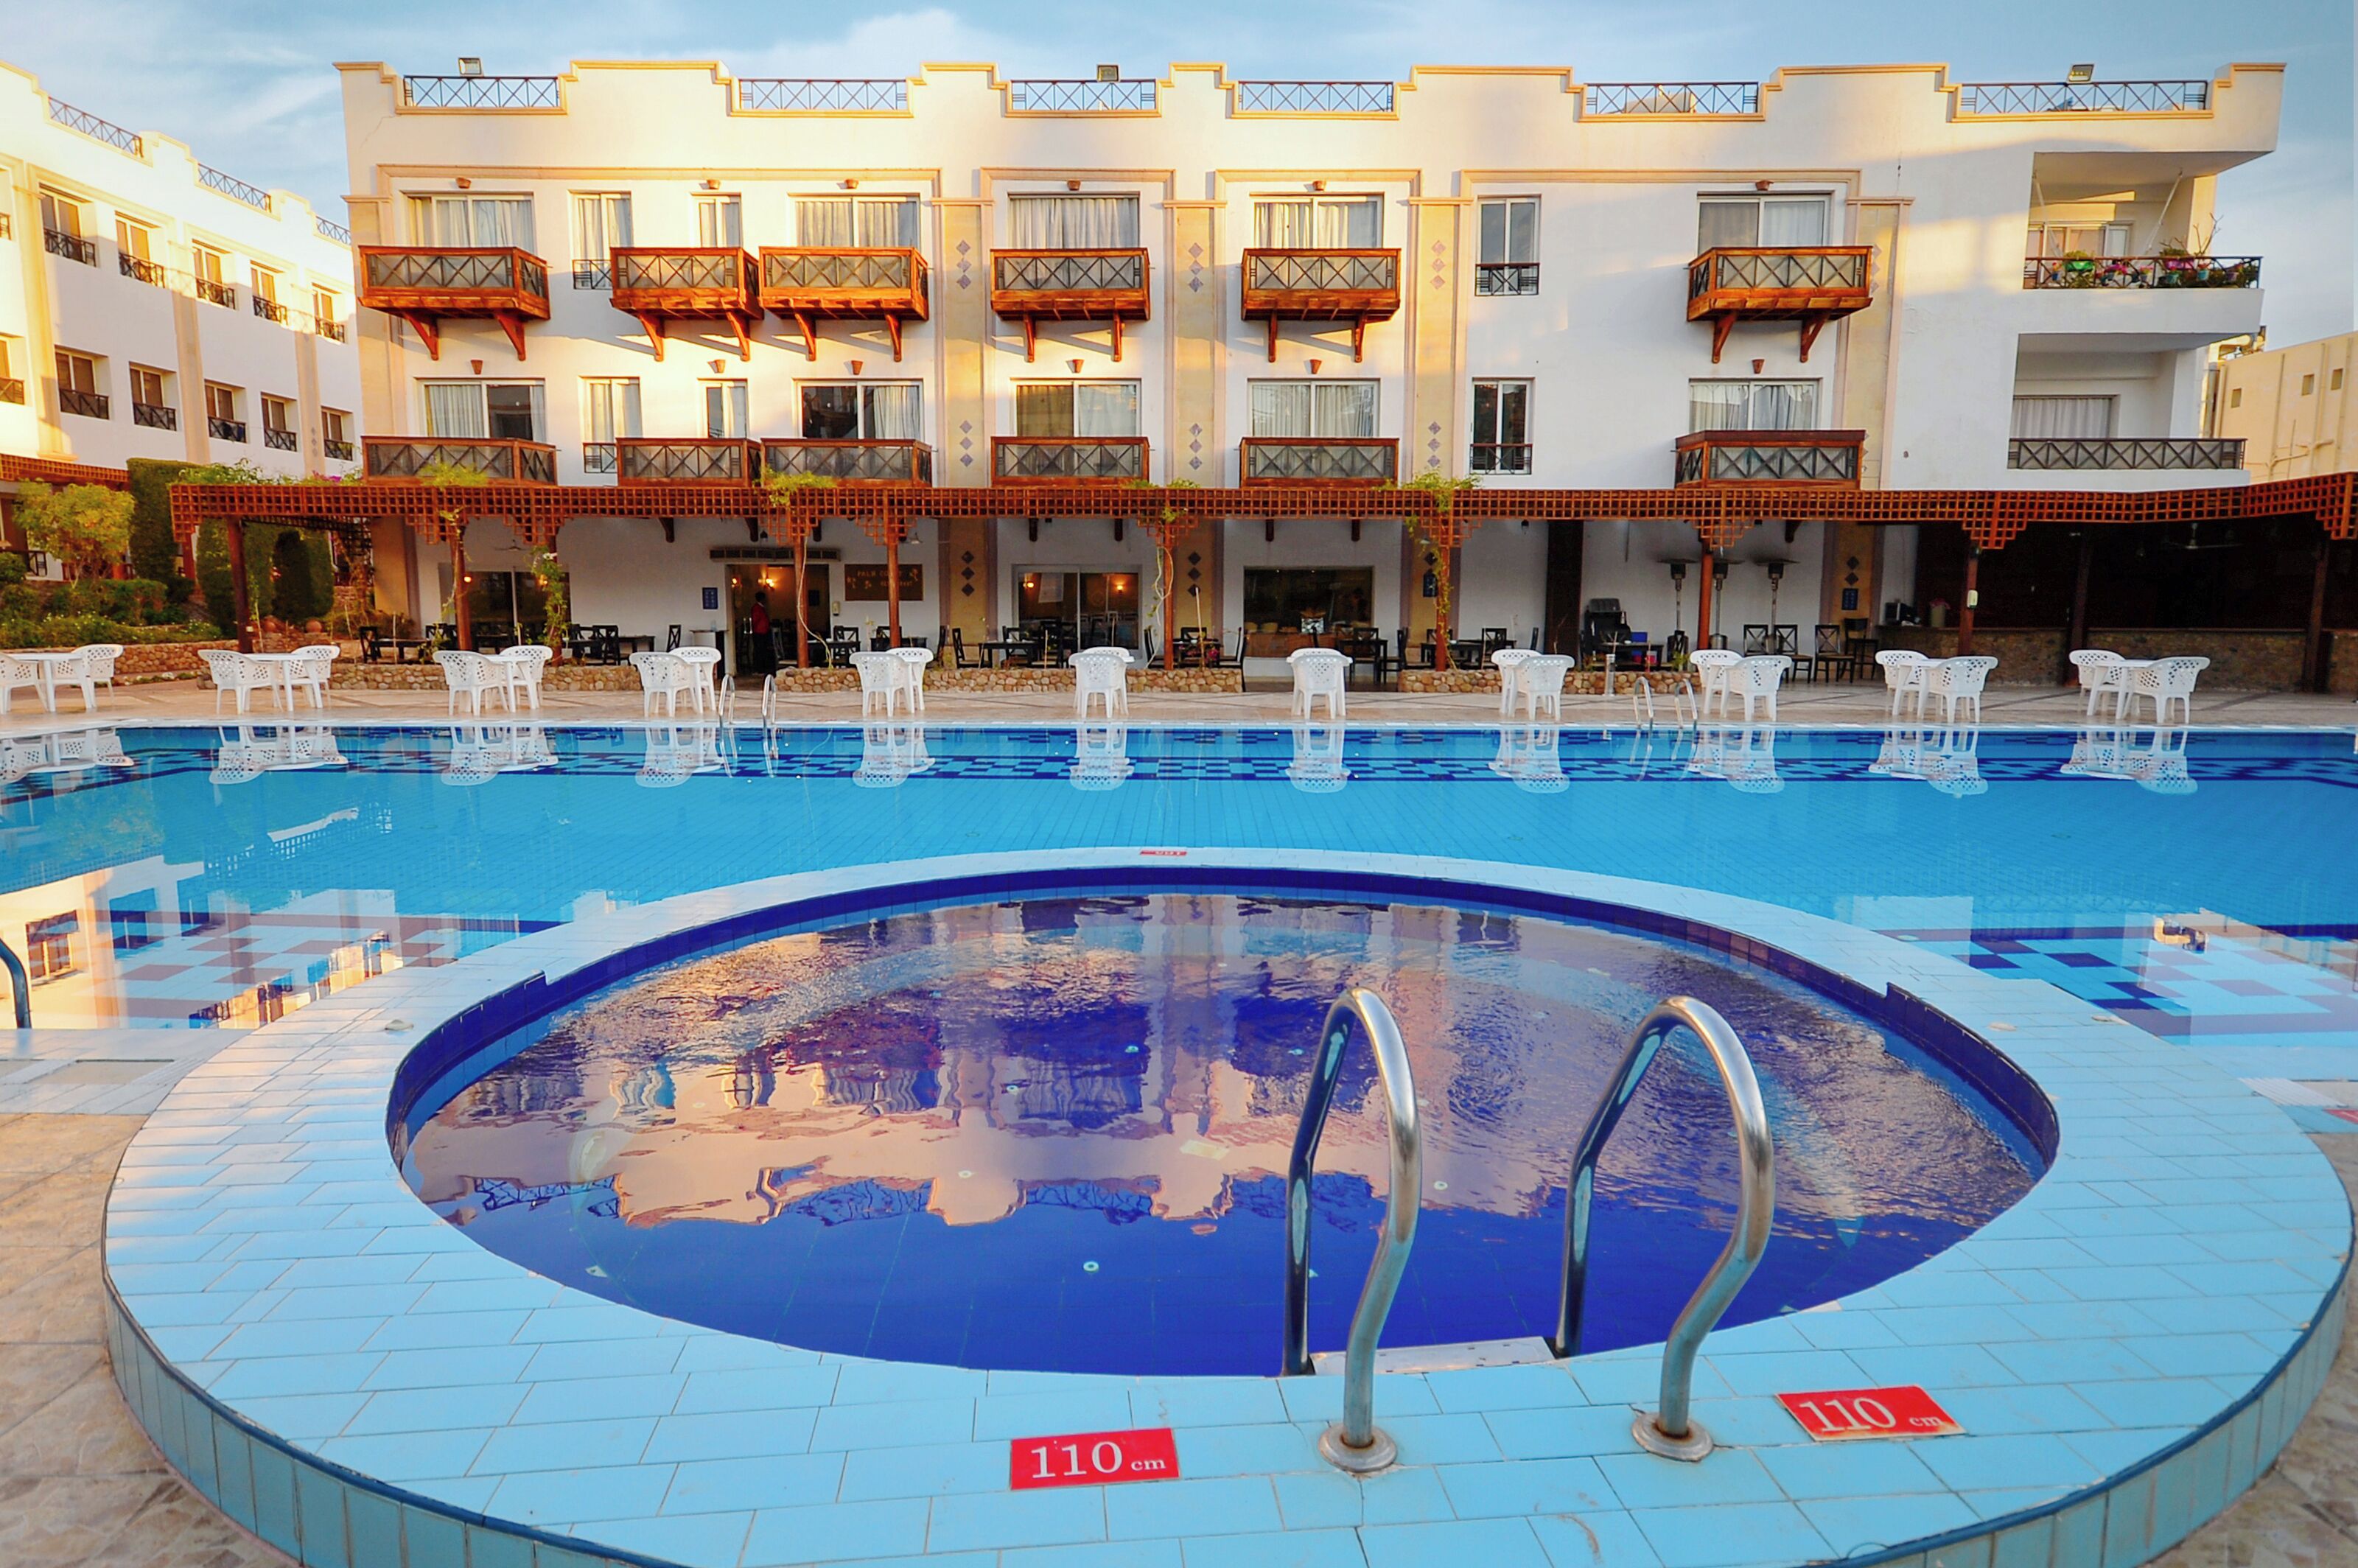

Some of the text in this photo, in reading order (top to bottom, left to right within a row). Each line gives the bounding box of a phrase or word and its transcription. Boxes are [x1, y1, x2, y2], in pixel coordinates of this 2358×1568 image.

[1799, 1397, 1942, 1432] 110 cm
[1031, 1441, 1166, 1478] 110 cm
